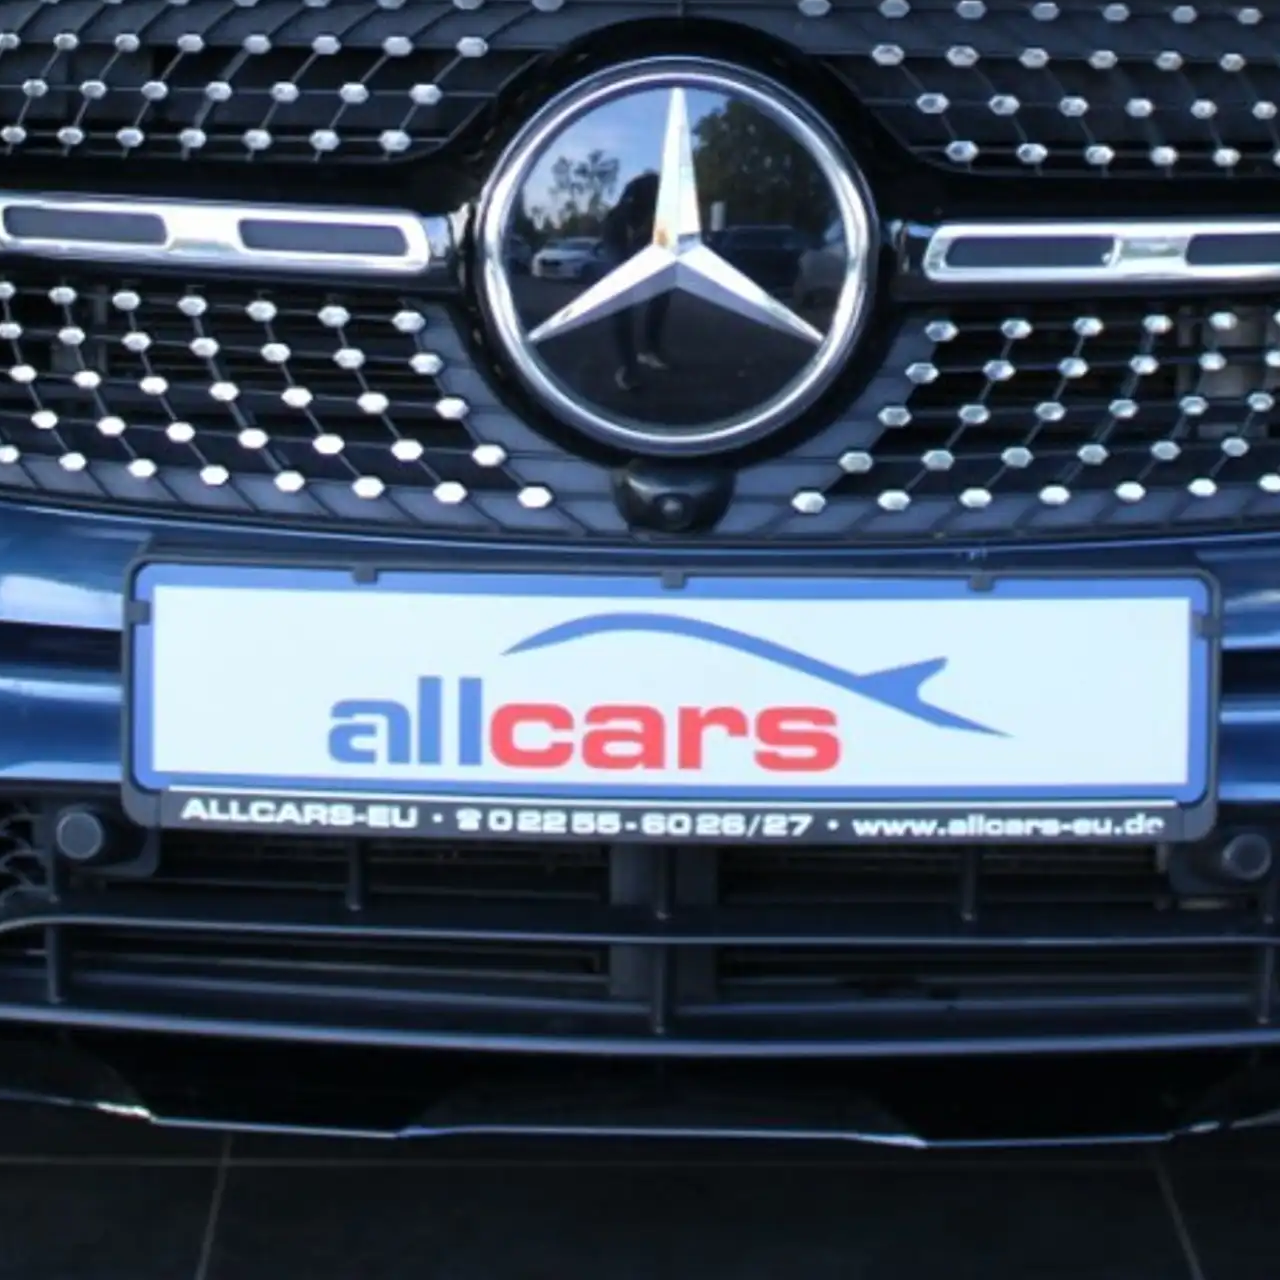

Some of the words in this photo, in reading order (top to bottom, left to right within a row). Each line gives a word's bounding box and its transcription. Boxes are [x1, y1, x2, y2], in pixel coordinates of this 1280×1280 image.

[328, 675, 842, 771] allcars
[181, 797, 418, 828] ALLCARS-EU
[851, 812, 1165, 837] www.allcars-eu.de
